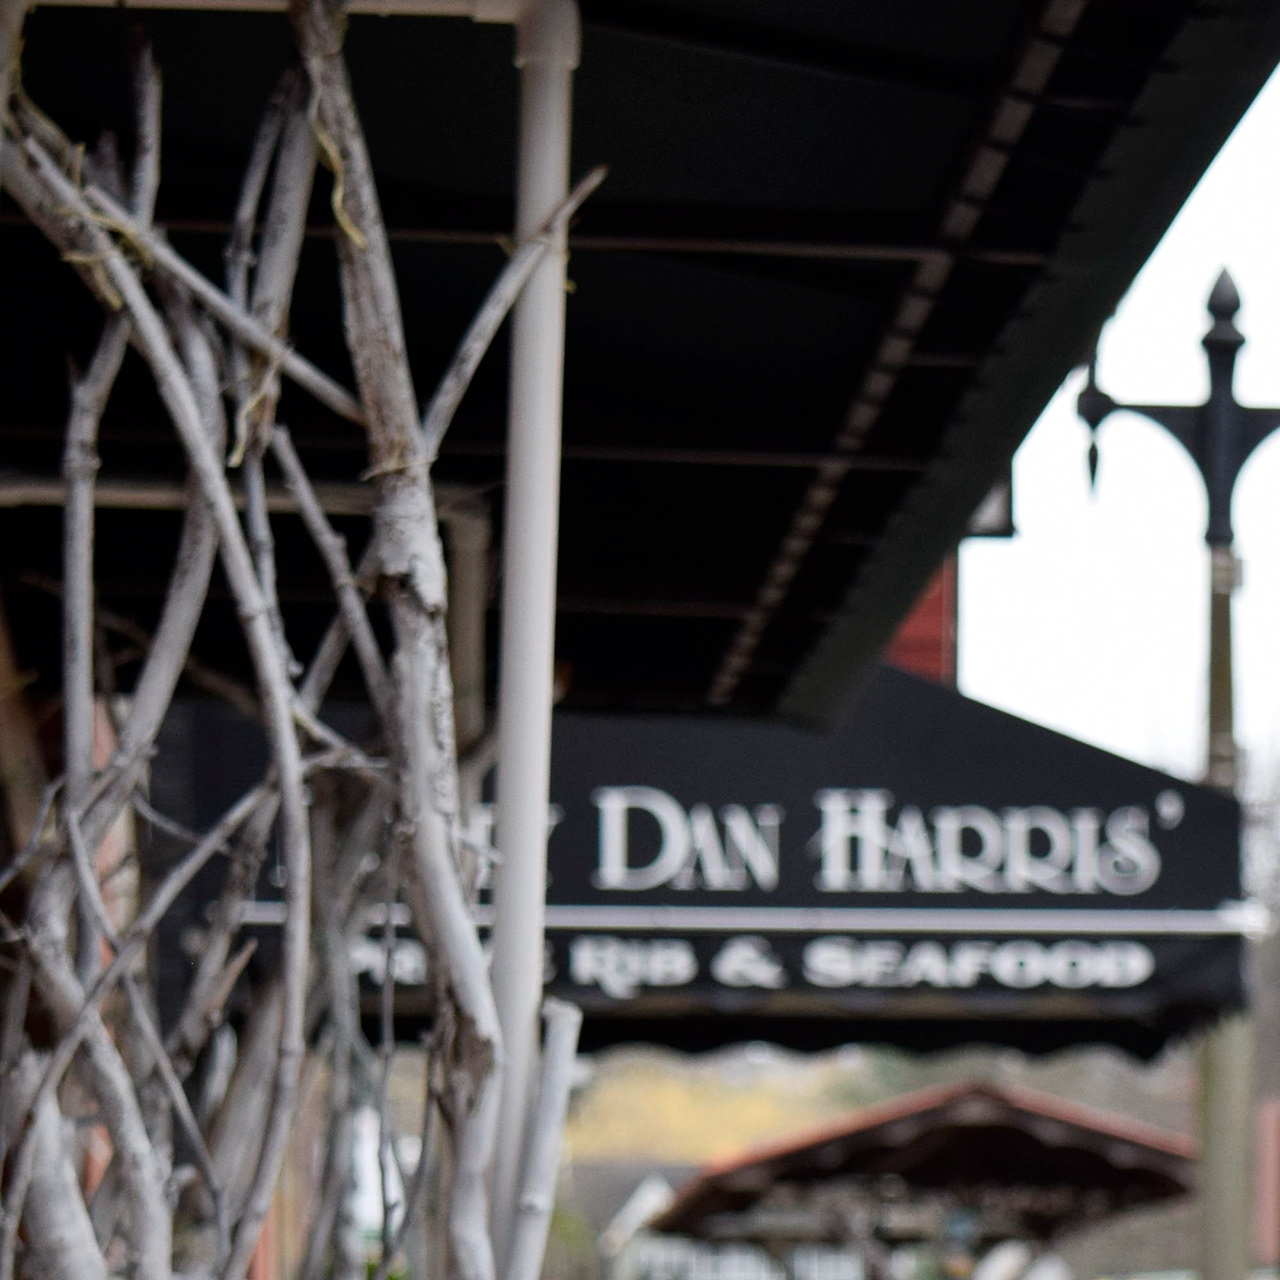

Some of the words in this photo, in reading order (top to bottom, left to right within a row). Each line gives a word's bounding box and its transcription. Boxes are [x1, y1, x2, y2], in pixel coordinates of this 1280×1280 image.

[592, 785, 786, 892] DAN
[809, 787, 1184, 896] HARRIS'
[711, 935, 788, 990] &
[803, 936, 1155, 989] SEAFOOD
